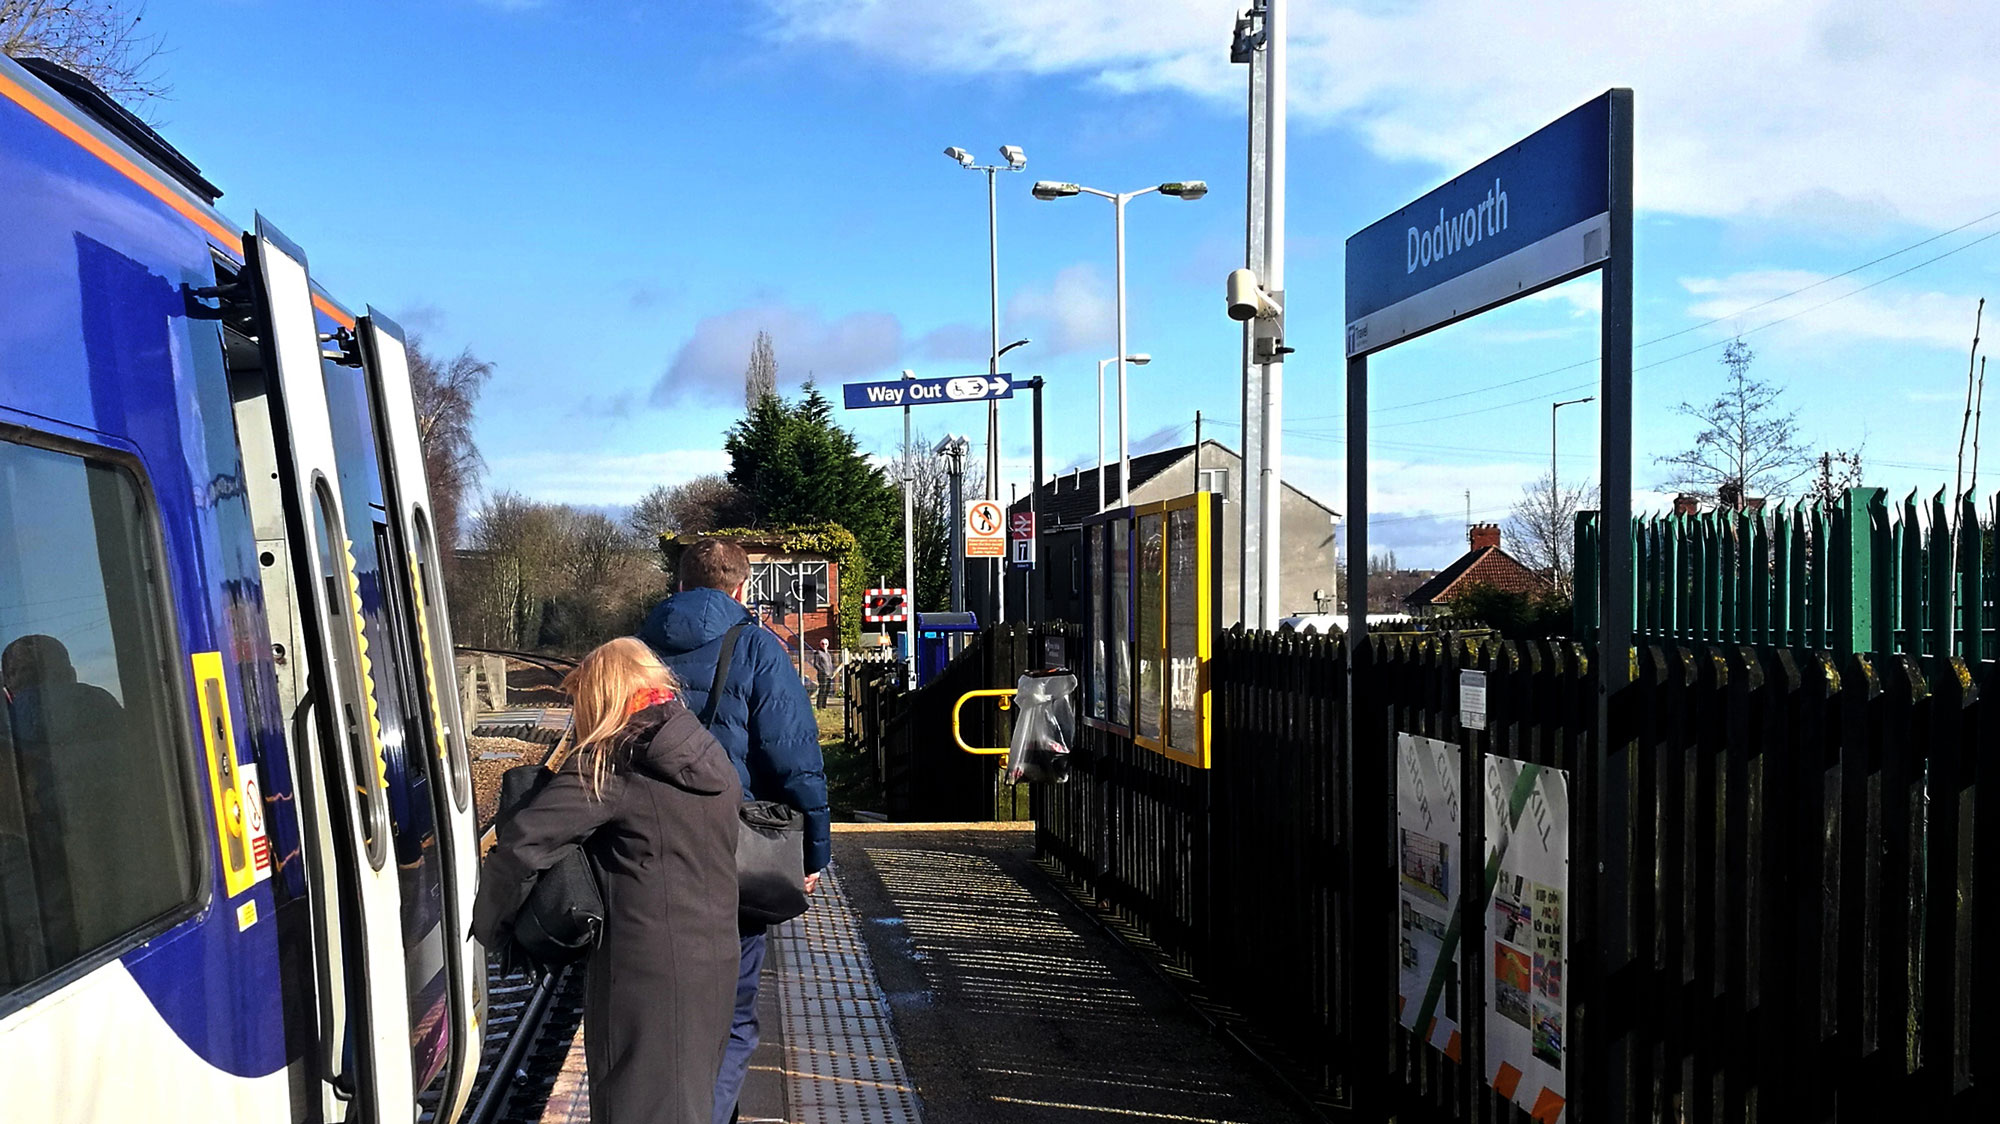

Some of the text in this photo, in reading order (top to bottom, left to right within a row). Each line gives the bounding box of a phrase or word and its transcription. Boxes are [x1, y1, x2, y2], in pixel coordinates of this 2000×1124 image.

[1407, 177, 1508, 275] Dodworth
[866, 382, 942, 405] Way Out
[1406, 746, 1434, 832] SHORT
[1436, 752, 1459, 823] CUTS
[1487, 764, 1508, 828] CAN
[1530, 790, 1552, 853] KILL
